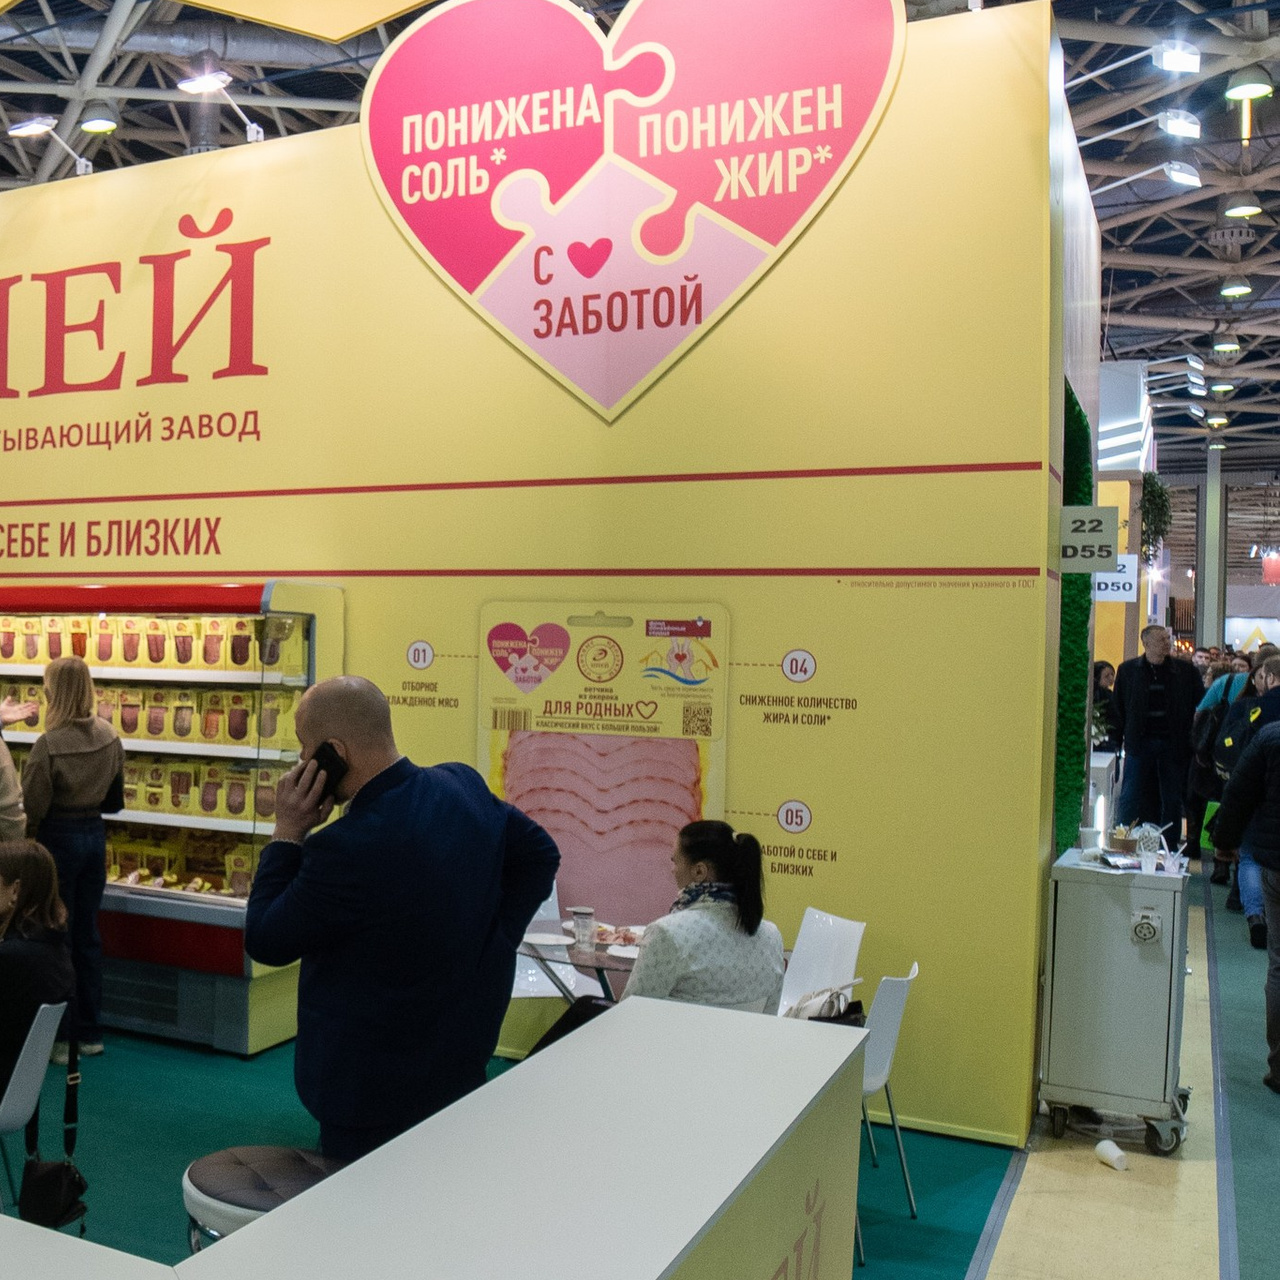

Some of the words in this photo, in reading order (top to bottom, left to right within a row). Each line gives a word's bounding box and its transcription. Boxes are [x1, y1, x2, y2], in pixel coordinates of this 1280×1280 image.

[401, 82, 602, 156] ПОНИЖЕНА
[638, 82, 844, 158] ПОНИЖЕН
[532, 244, 555, 286] С
[532, 274, 704, 340] ЗАБОТОЙ
[159, 409, 262, 445] ЗАВОД
[1071, 519, 1104, 534] 22
[59, 522, 76, 558] И
[84, 517, 222, 557] БЛИЗКИХ
[1061, 544, 1113, 559] D55
[1117, 564, 1127, 574] 2
[1096, 581, 1133, 592] D50
[412, 648, 427, 664] 01
[789, 657, 808, 676] 04
[402, 681, 438, 693] ОТБОРНОЕ
[387, 696, 436, 708] ХЛАЖДЕННОЕ
[437, 698, 459, 709] МЯСО
[542, 700, 572, 716] ДЛЯ
[576, 701, 634, 719] РОДНЫХ
[739, 693, 796, 708] СНИЖЕННОЕ
[797, 695, 858, 711] КОЛИЧЕСТВО
[535, 720, 580, 729] КЛАССИЧЕСКИЙ
[581, 721, 595, 730] ВКУС
[601, 722, 630, 731] БОЛЬШЕЙ
[762, 711, 791, 725] ЖИРА
[792, 713, 799, 725] И
[785, 808, 803, 826] 05
[761, 844, 796, 858] АБОТОЙ
[798, 849, 804, 859] О
[806, 848, 828, 862] СЕБЕ
[830, 850, 837, 862] И
[770, 862, 814, 877] БЛИЗКИХ
